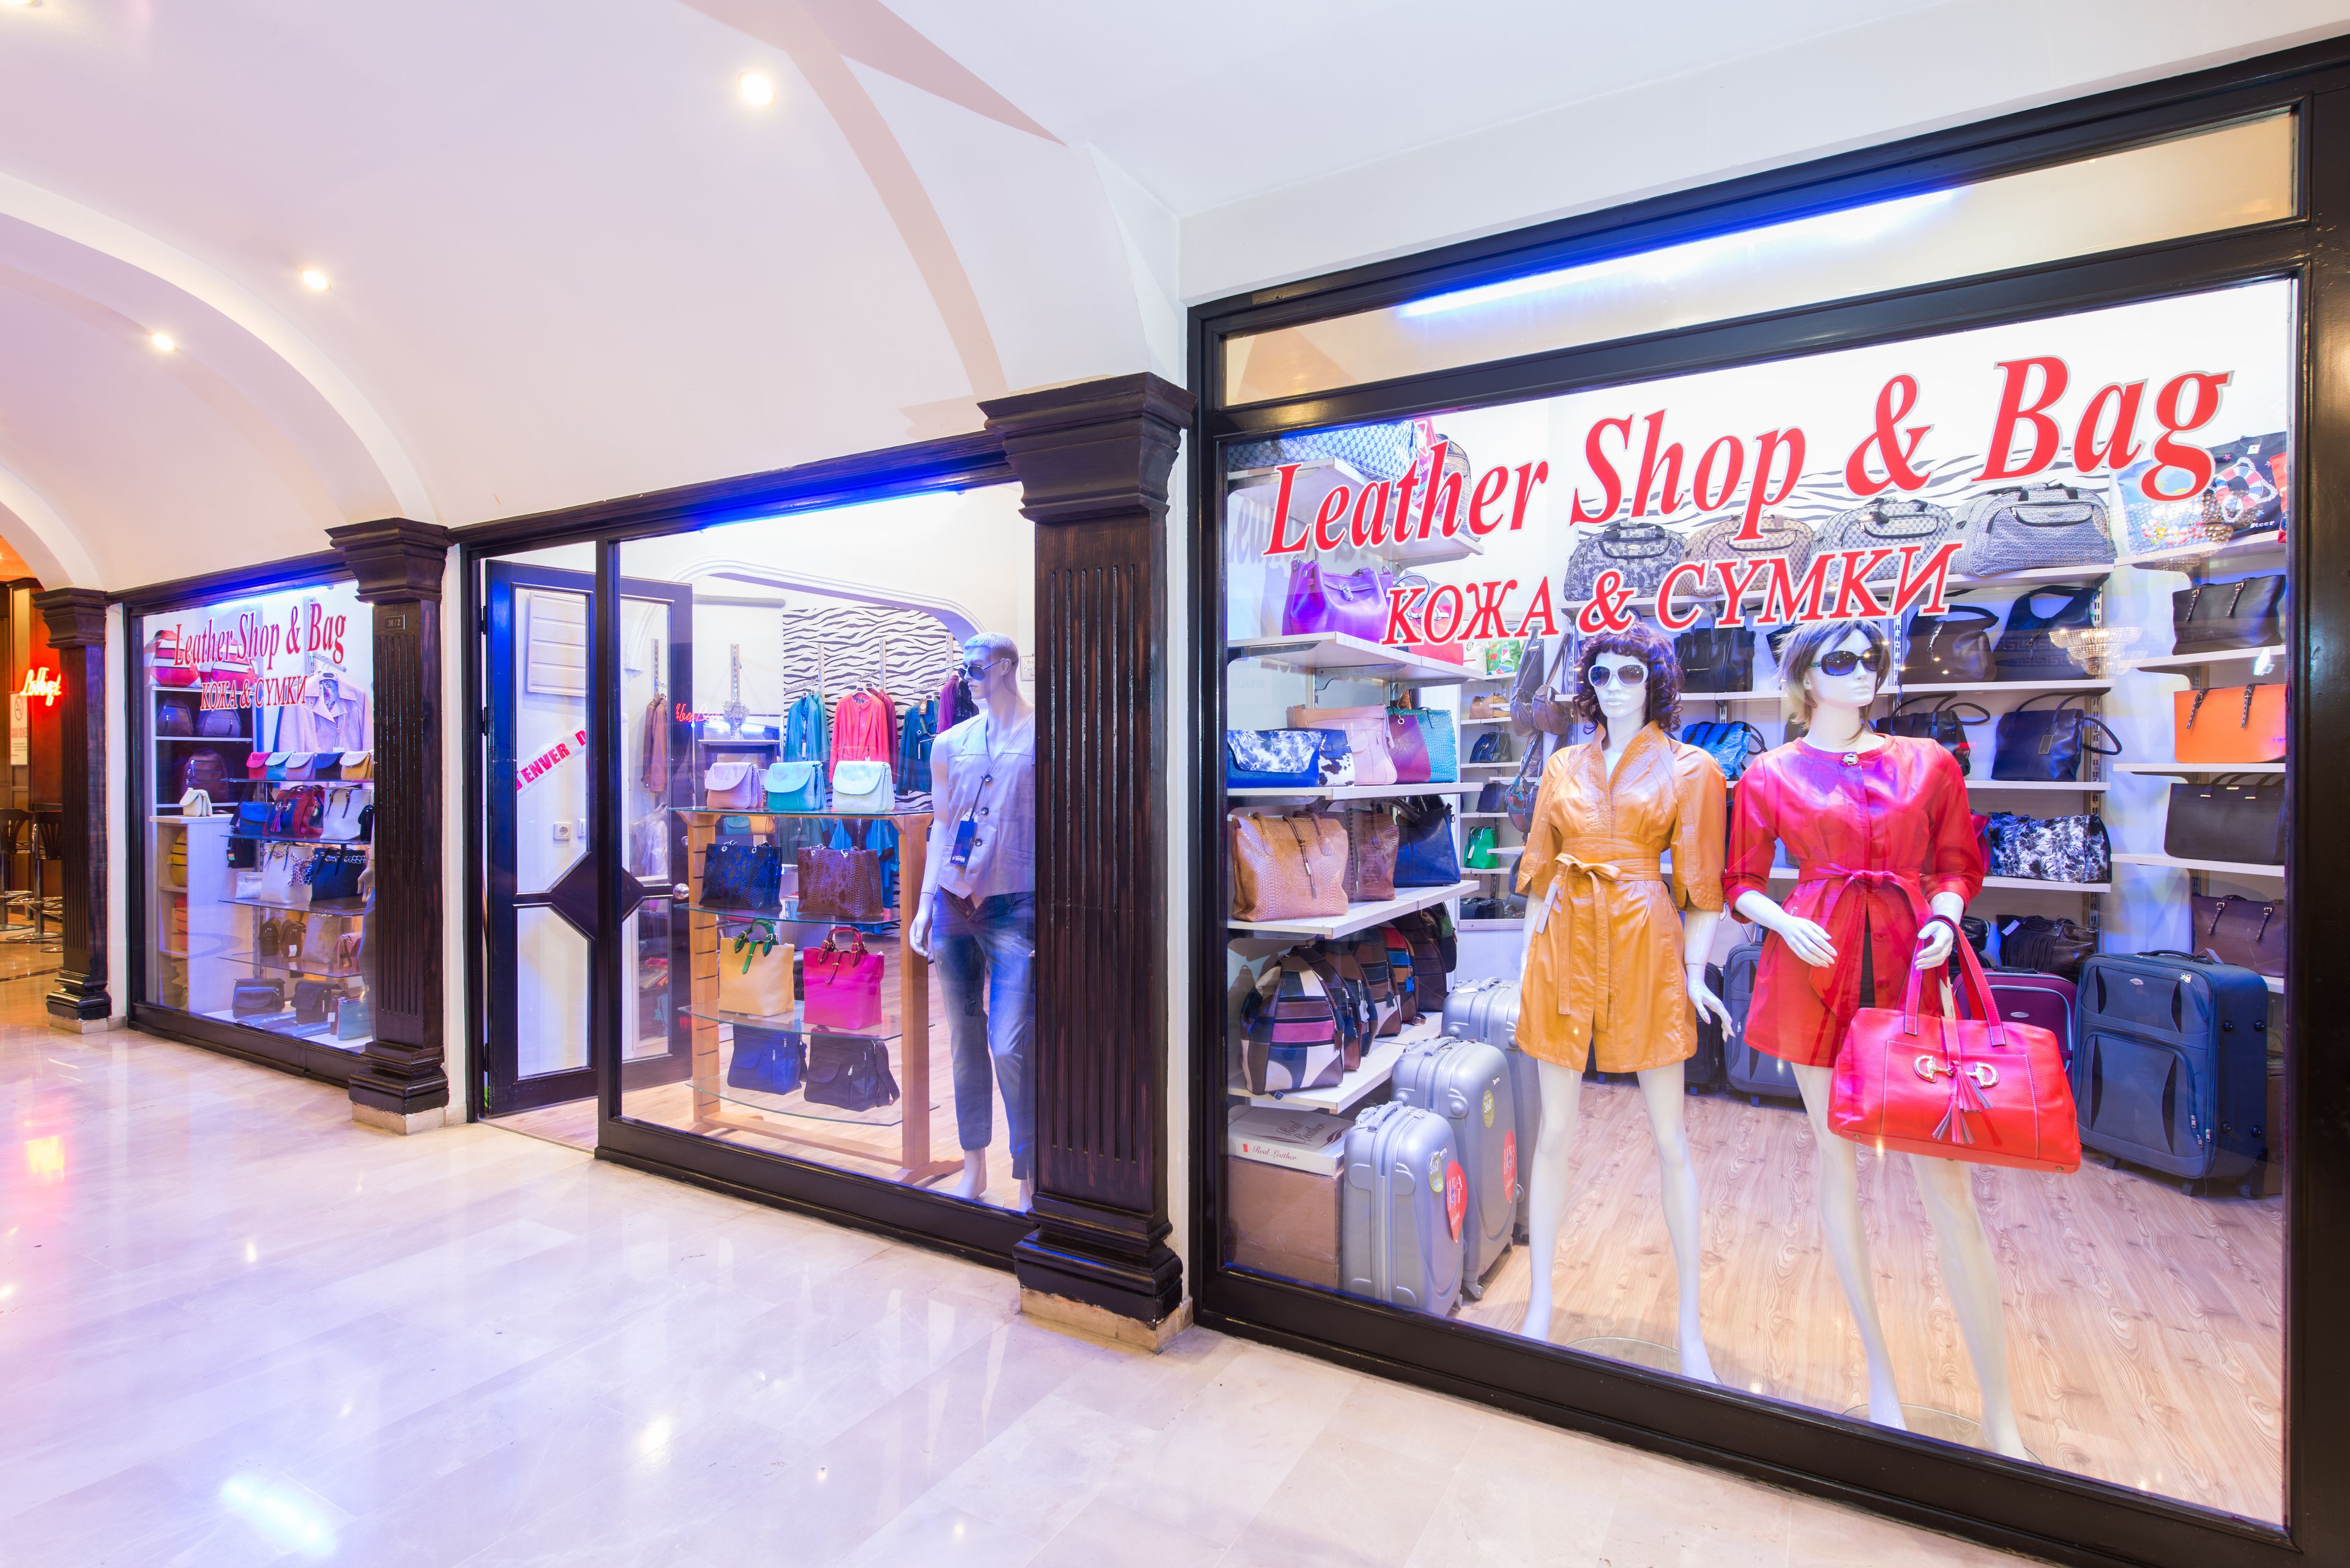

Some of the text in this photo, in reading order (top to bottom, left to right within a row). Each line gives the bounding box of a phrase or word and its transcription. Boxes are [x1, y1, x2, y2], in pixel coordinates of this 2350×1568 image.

[1263, 441, 1549, 556] Leather
[1569, 410, 1807, 541] Shop
[1845, 374, 1931, 497] &
[1972, 356, 2234, 502] Bag
[1381, 577, 1561, 646] КОЖА
[1578, 570, 1636, 634] &
[174, 603, 346, 670] Leather Shop & Bag
[200, 681, 238, 711] КОЖА
[239, 679, 252, 709] &
[1276, 1120, 1304, 1136] Real
[1294, 1122, 1326, 1144] Leather
[1253, 1145, 1297, 1161] Real Leather
